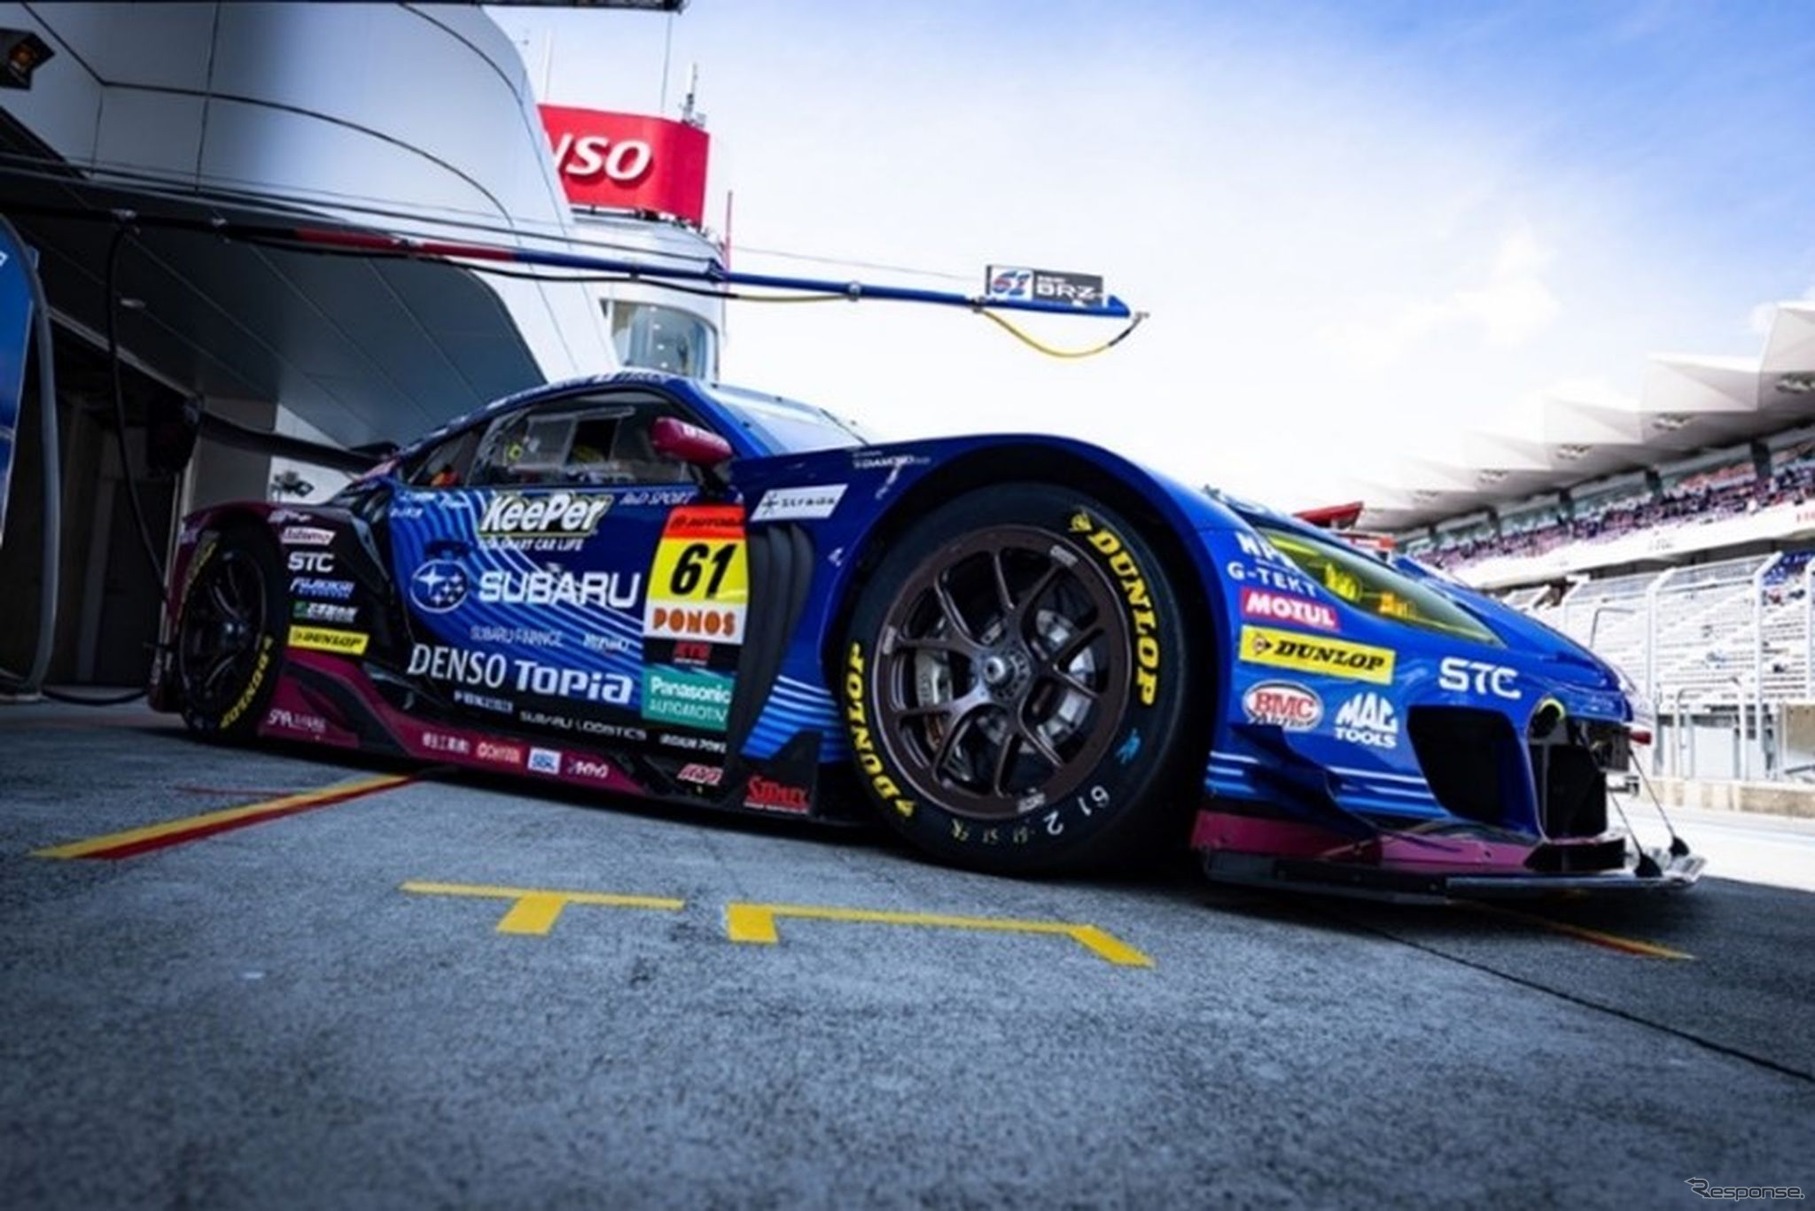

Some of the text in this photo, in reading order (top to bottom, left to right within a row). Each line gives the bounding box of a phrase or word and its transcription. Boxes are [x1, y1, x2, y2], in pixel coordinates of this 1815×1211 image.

[1036, 283, 1096, 300] BRZ
[480, 492, 610, 532] KeePer
[534, 540, 557, 552] CAR
[288, 551, 335, 573] STC
[670, 543, 737, 598] 61
[478, 571, 641, 608] SUBARU
[653, 608, 736, 636] PONOS
[1087, 529, 1160, 706] DUNLOP
[1246, 592, 1336, 627] MOTUL
[303, 632, 363, 647] DUNLOP
[408, 644, 507, 688] DENSO
[1274, 640, 1386, 671] DUNLOP
[651, 676, 732, 704] Panasonic
[1439, 657, 1522, 699] STC
[519, 710, 573, 730] SUBARU
[1254, 691, 1314, 719] BMC
[1334, 691, 1399, 733] MAC
[845, 642, 900, 801] DUNLOP
[1334, 727, 1397, 748] TOOLS
